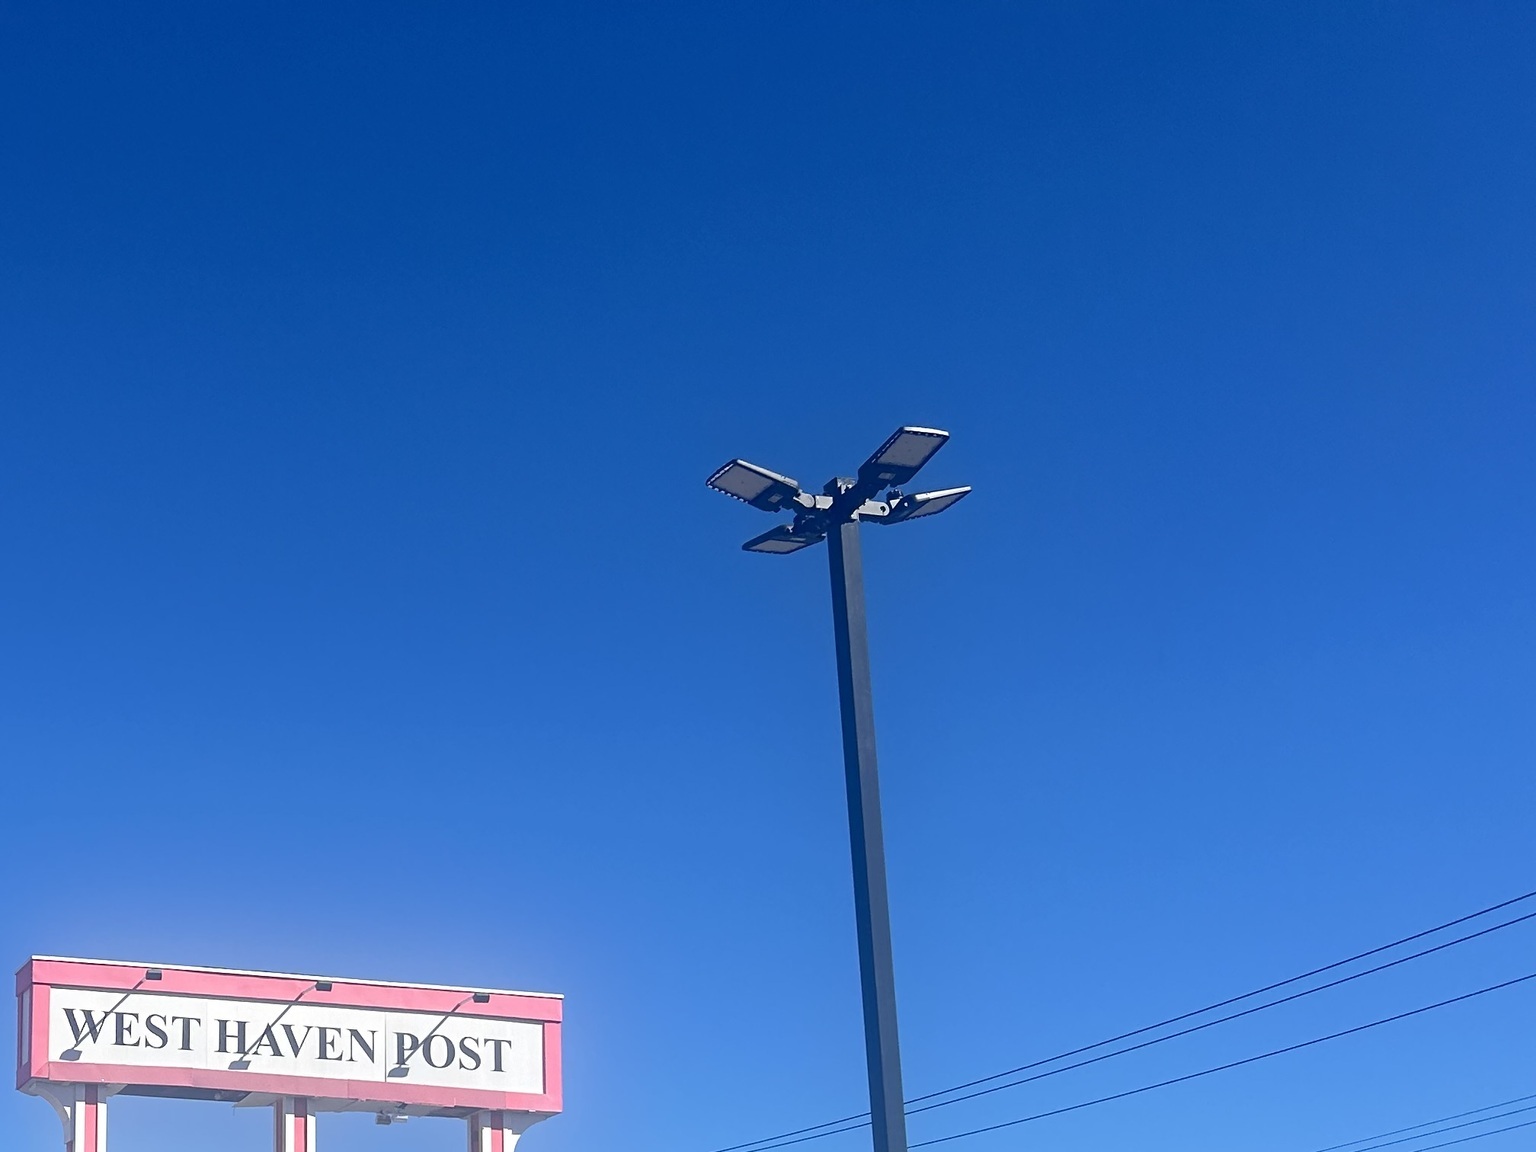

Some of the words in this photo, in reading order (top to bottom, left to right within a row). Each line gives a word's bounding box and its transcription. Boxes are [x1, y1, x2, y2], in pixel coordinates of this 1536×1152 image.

[63, 1007, 202, 1052] WEST
[213, 1018, 378, 1065] HAVEN
[393, 1031, 513, 1073] POST
